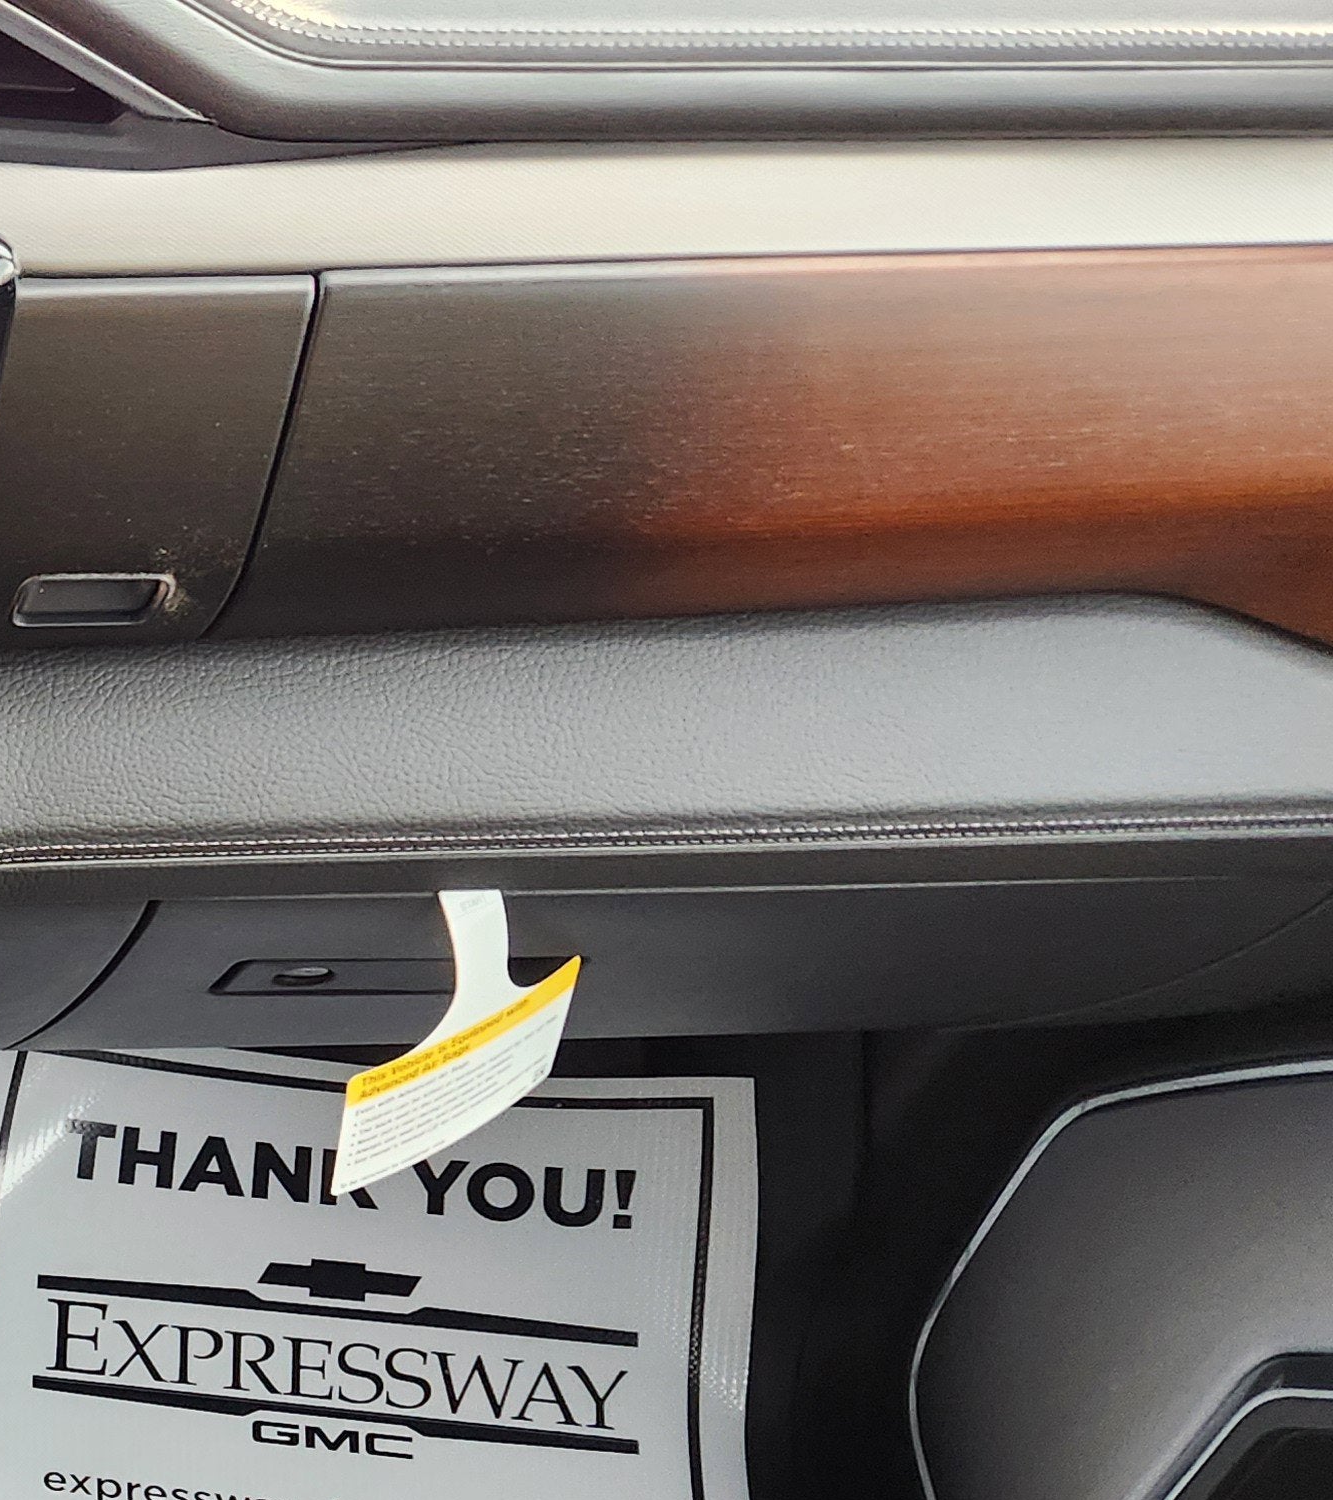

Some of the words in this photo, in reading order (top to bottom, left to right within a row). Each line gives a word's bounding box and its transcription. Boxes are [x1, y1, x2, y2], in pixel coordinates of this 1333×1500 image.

[413, 1158, 636, 1231] YOU!
[45, 1298, 628, 1431] EXPRESSWAY
[251, 1419, 416, 1461] GMC
